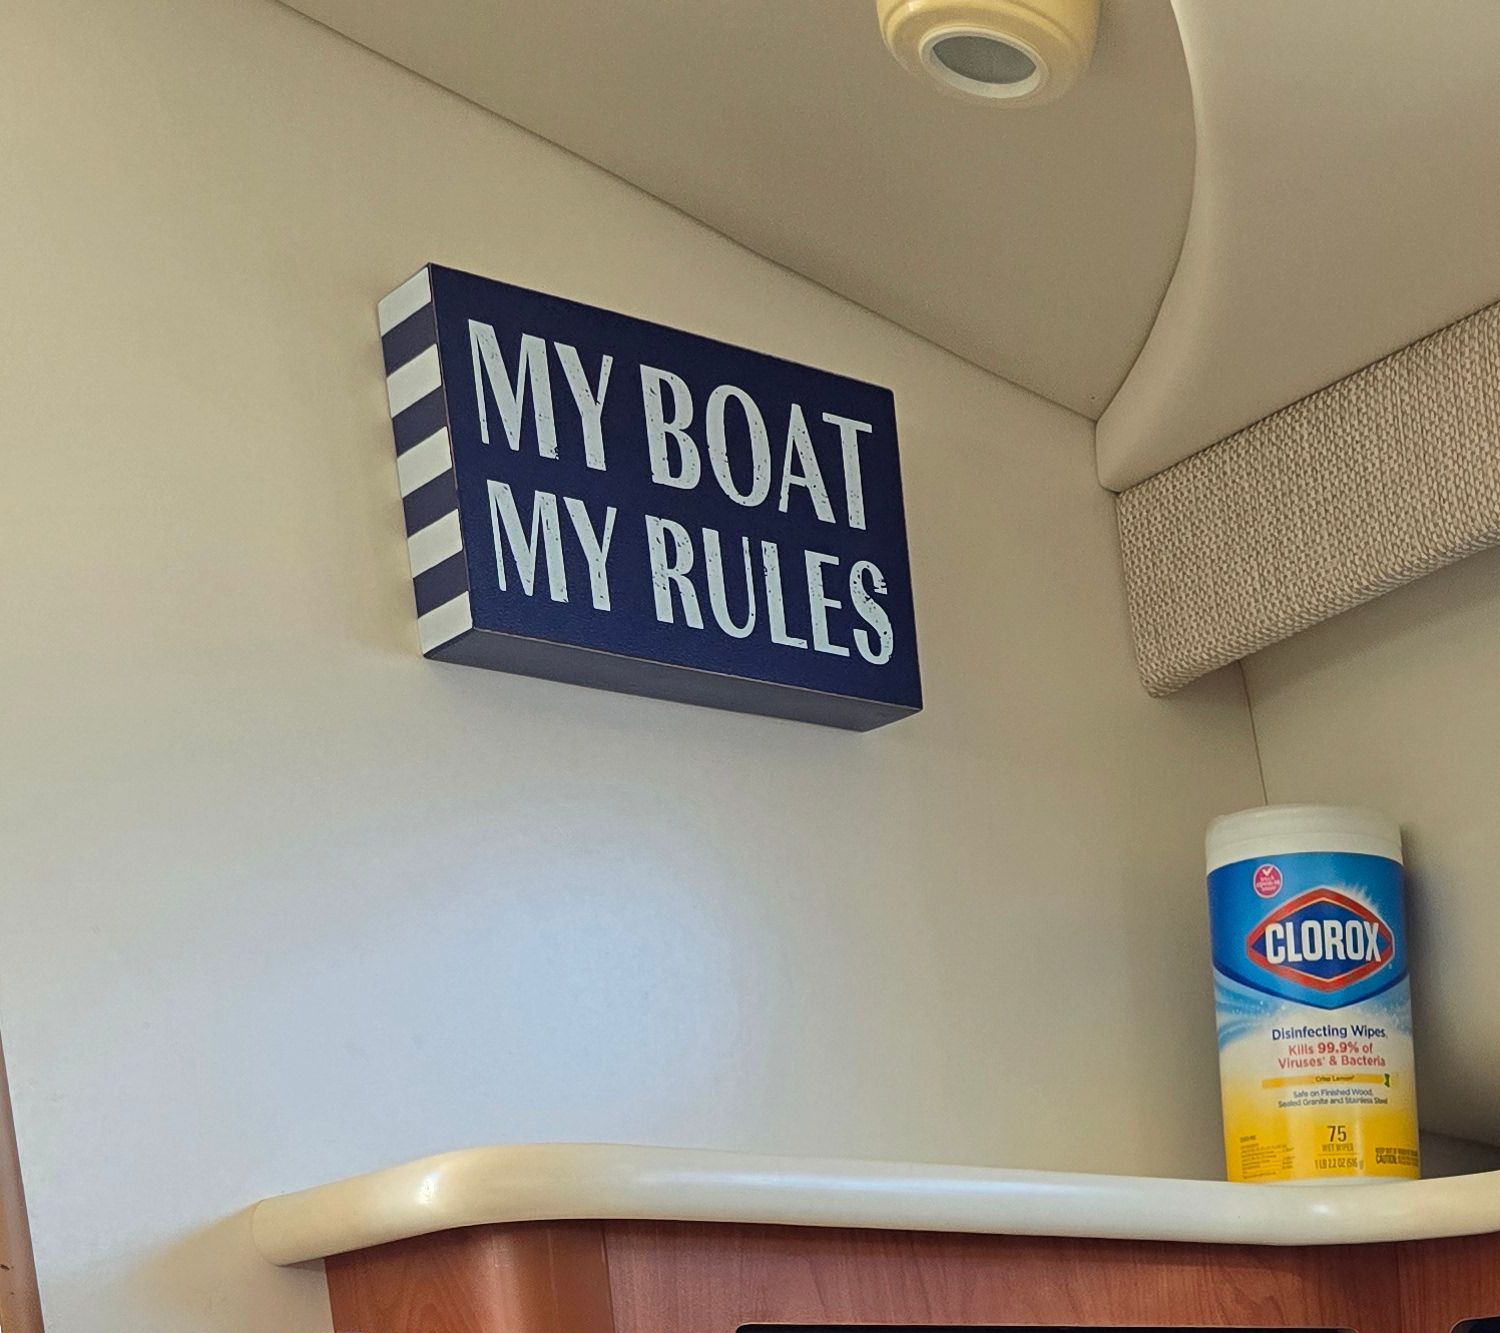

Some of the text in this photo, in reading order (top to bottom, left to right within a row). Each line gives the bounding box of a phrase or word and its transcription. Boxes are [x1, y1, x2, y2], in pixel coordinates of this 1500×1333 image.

[468, 319, 873, 531] MY BOAT
[486, 479, 893, 665] MY RULES
[1265, 920, 1381, 964] CLOROX
[1272, 1025, 1347, 1040] Disinfecting
[1288, 1041, 1373, 1056] Kills 99.9% of
[1329, 1056, 1337, 1066] &
[1341, 1055, 1386, 1066] Bacteria
[1327, 1125, 1347, 1142] 75
